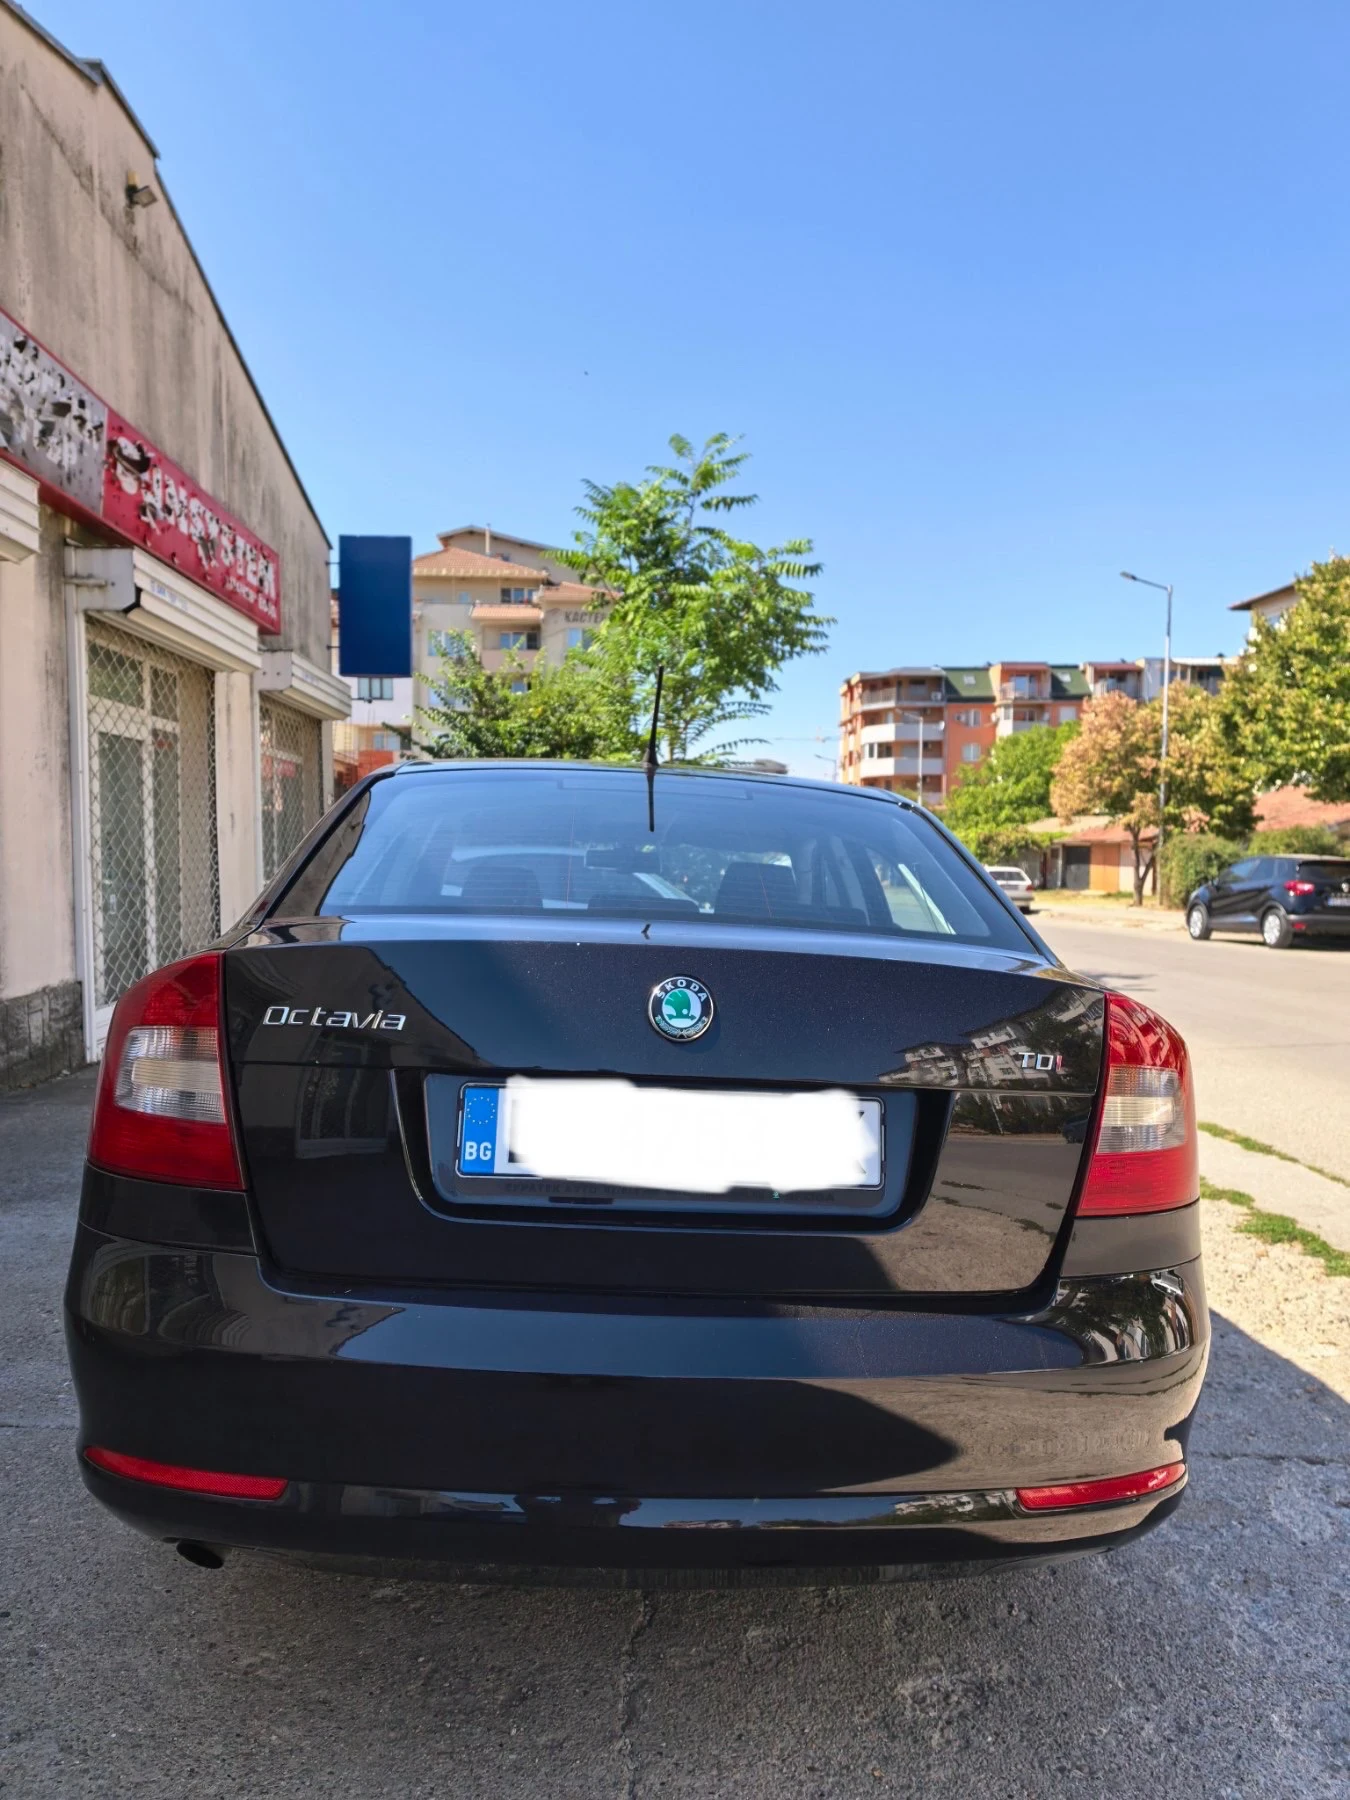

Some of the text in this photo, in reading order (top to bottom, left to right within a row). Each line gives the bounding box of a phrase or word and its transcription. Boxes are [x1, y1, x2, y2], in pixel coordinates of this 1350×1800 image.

[262, 1006, 406, 1031] Octavia
[1018, 1052, 1063, 1071] TDI
[464, 1141, 492, 1161] BG
